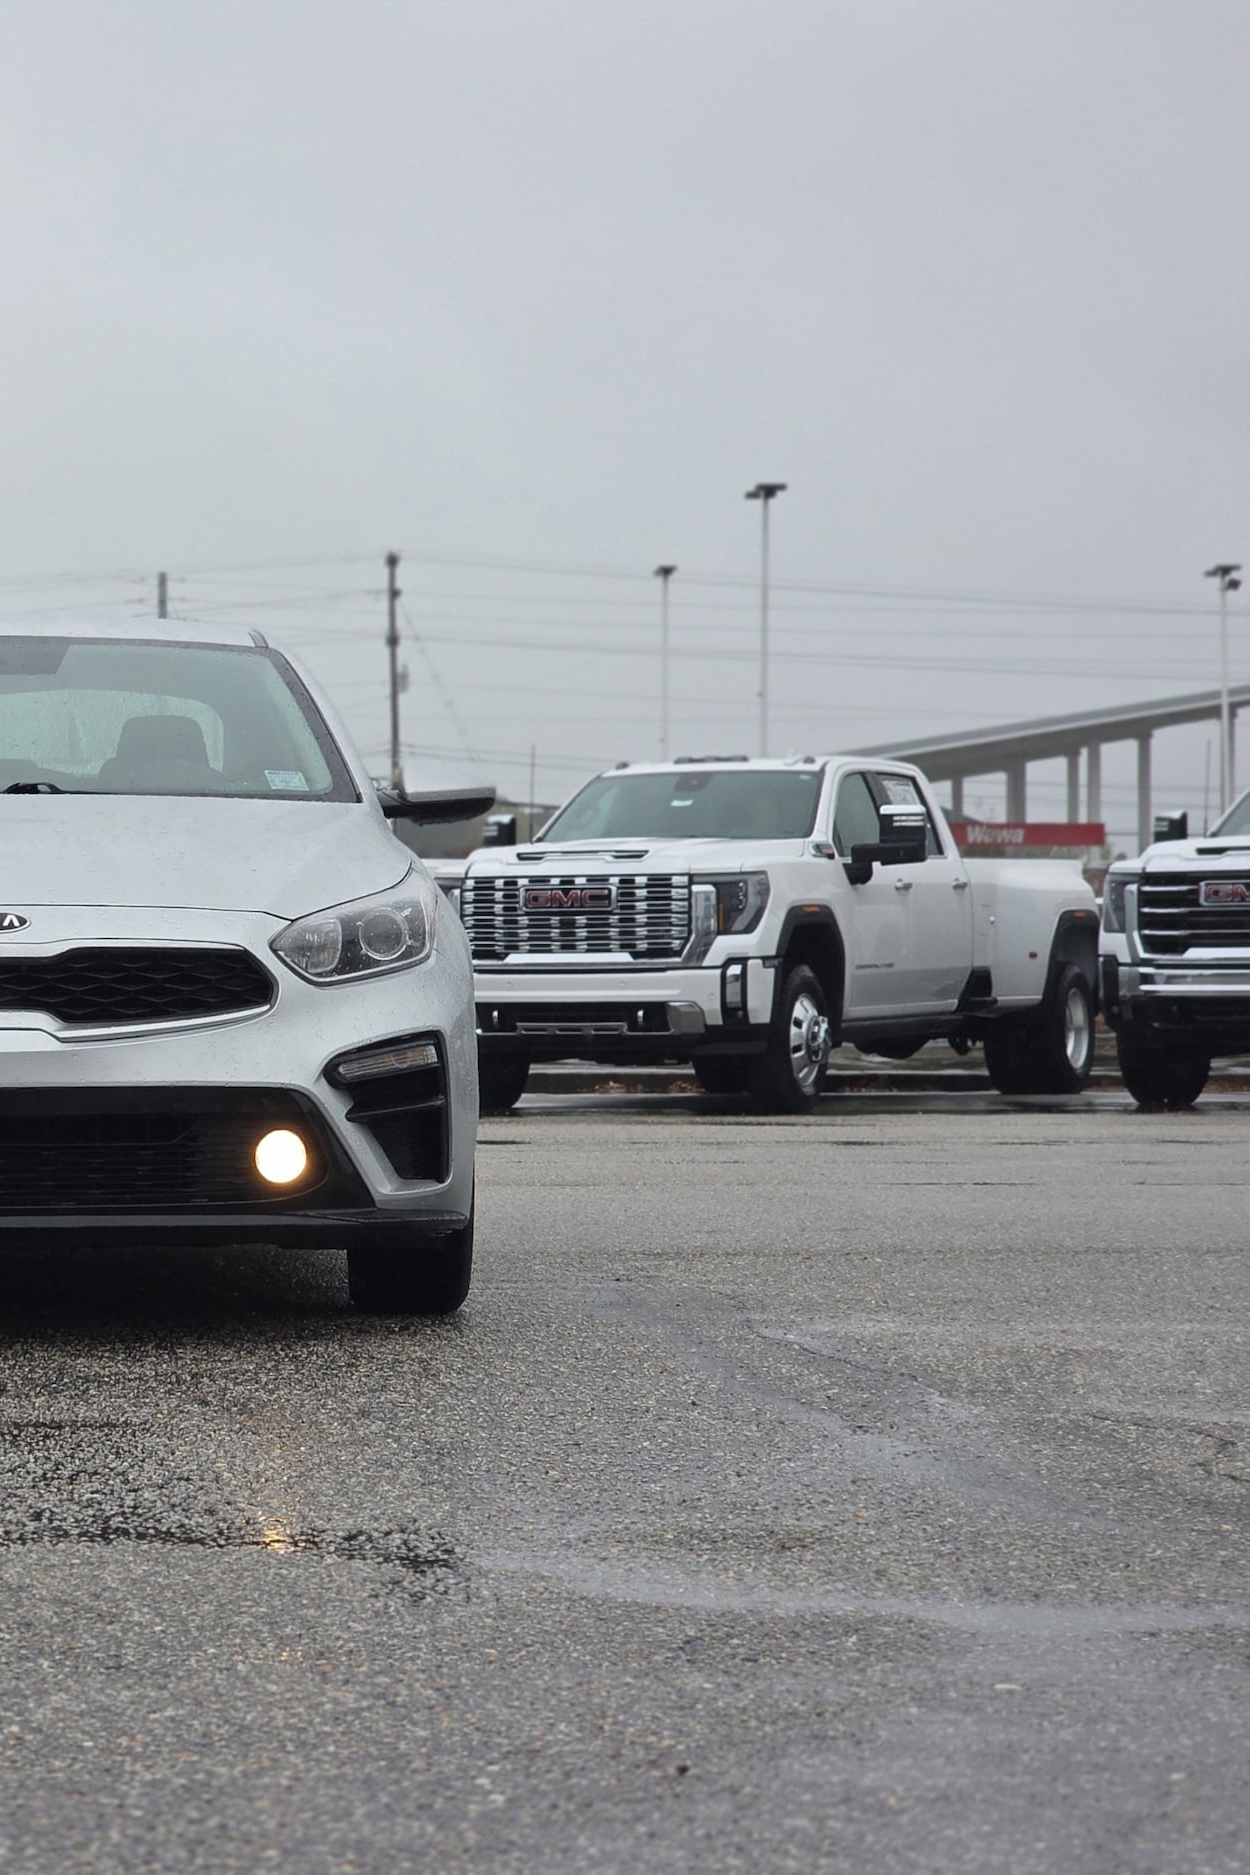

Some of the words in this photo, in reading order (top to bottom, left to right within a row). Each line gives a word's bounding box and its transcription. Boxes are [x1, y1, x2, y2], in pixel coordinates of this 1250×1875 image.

[967, 825, 1024, 844] Wawa
[526, 889, 609, 908] GMC
[1206, 884, 1250, 901] GM
